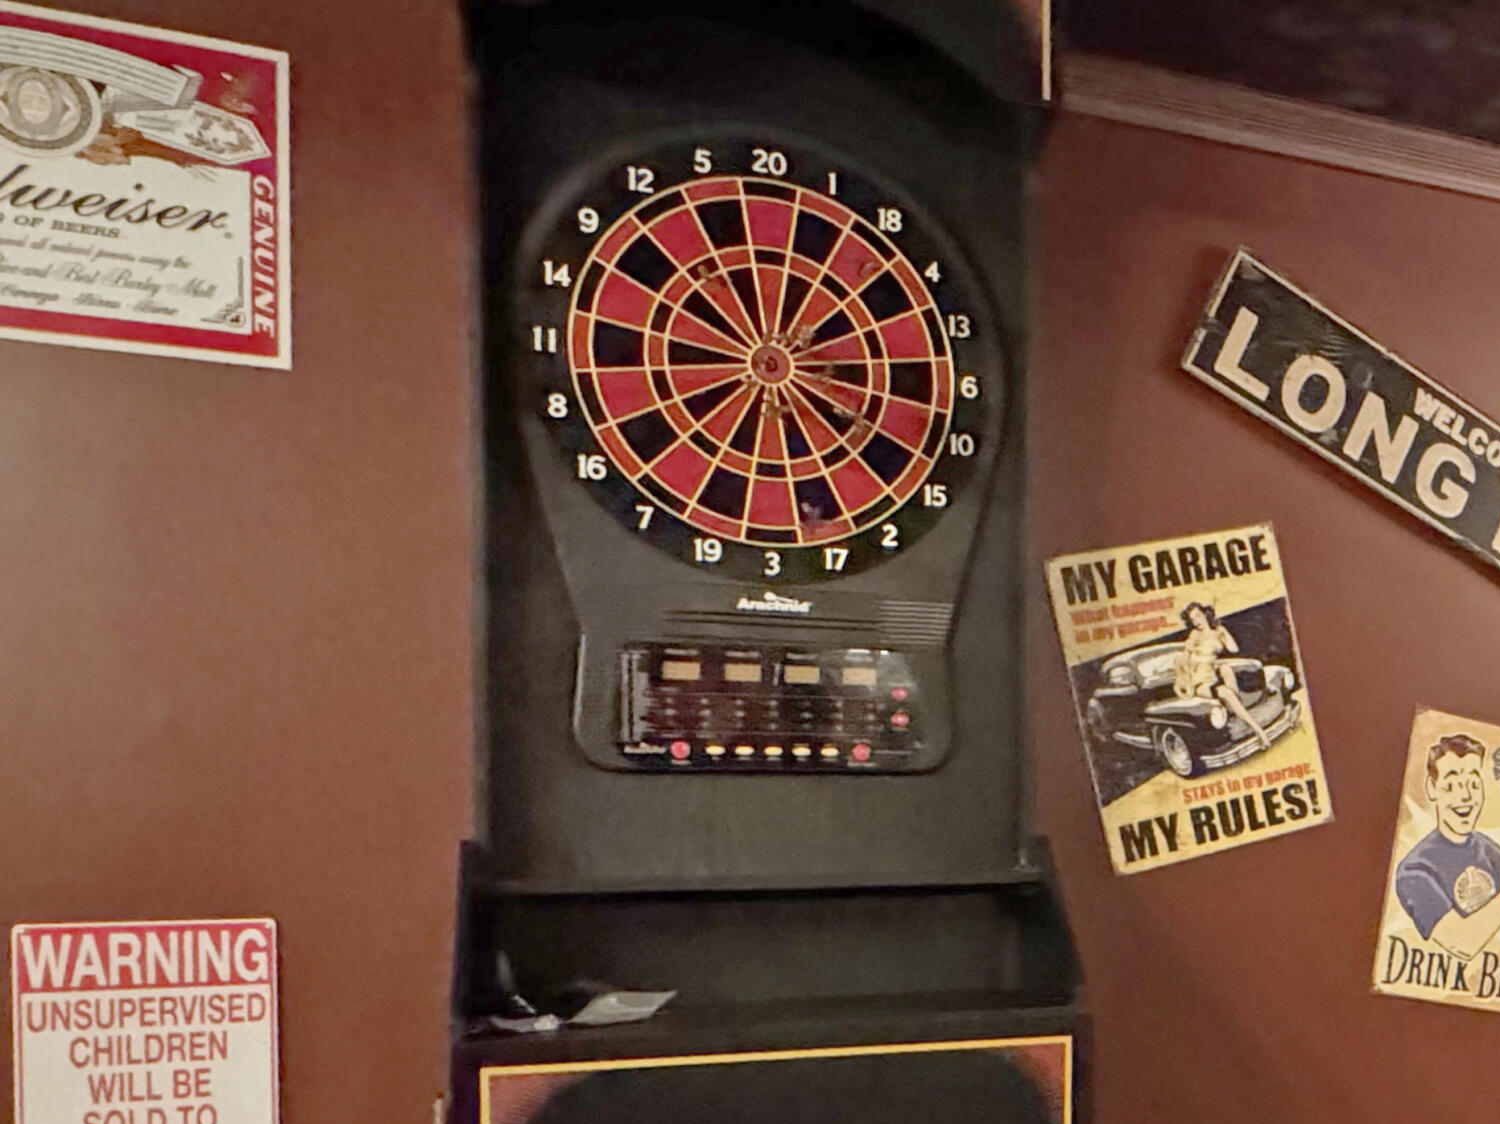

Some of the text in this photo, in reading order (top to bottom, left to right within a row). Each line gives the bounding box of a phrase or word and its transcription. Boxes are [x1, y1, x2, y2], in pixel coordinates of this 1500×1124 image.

[693, 148, 712, 174] 5
[751, 149, 788, 177] 20
[627, 166, 654, 194] 12
[828, 172, 837, 195] 1
[13, 214, 44, 229] OF
[50, 220, 121, 239] BEERS
[577, 207, 599, 234] 9
[877, 208, 903, 234] 18
[252, 174, 277, 339] GENUINE
[543, 260, 572, 288] 14
[923, 260, 942, 283] 4
[532, 325, 557, 353] 11
[947, 314, 971, 338] 13
[960, 375, 979, 399] 6
[547, 392, 568, 418] 8
[1213, 306, 1478, 520] LONG
[950, 433, 974, 457] 10
[577, 454, 607, 481] 16
[923, 483, 948, 508] 15
[635, 505, 655, 530] 7
[881, 523, 899, 548] 2
[693, 537, 723, 563] 19
[823, 547, 849, 571] 17
[764, 551, 781, 577] 3
[1060, 534, 1272, 606] MY GARAGE
[1182, 779, 1226, 805] STAYS
[1227, 777, 1242, 793] in
[1242, 774, 1264, 790] my
[1119, 778, 1323, 864] MY RULES!
[20, 928, 269, 989] WARNING
[1381, 935, 1470, 992] DRINK
[26, 992, 267, 1033] UNSUPERVISED
[69, 1030, 229, 1069] CHILDREN
[87, 1068, 212, 1104] WILL BE
